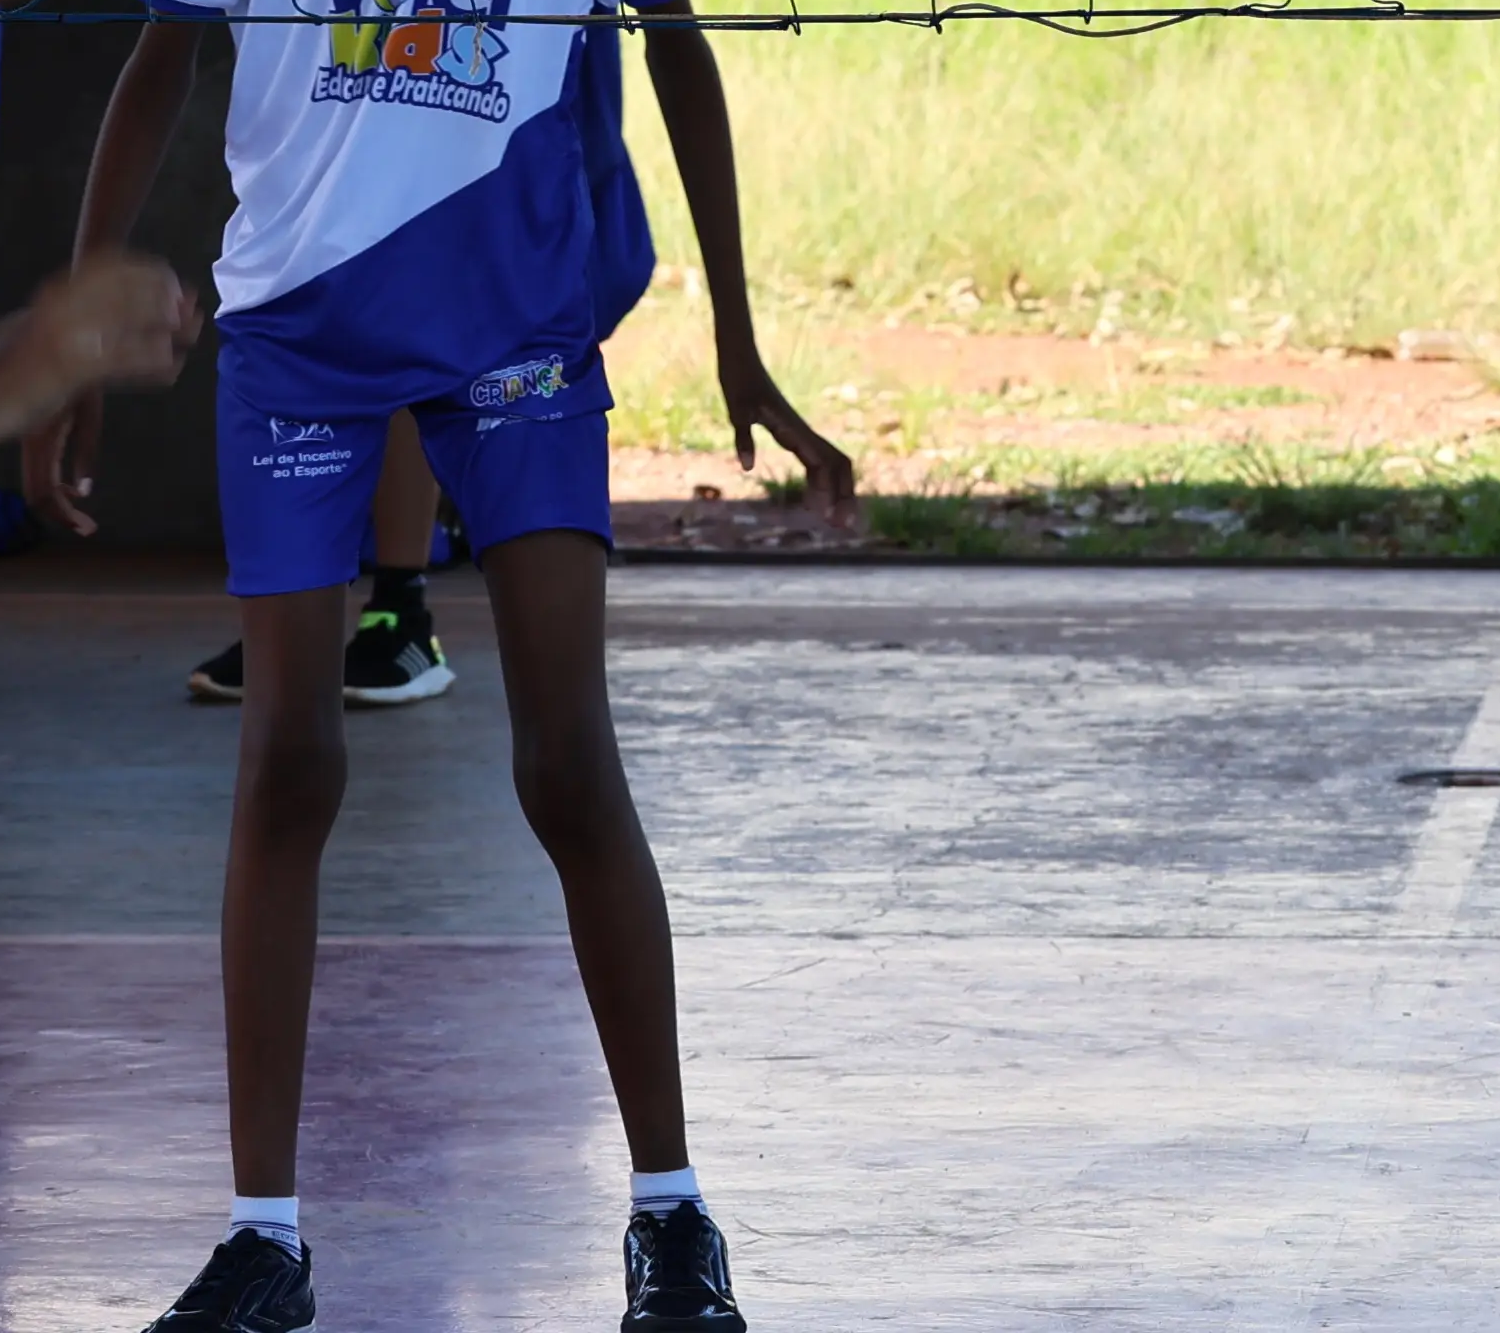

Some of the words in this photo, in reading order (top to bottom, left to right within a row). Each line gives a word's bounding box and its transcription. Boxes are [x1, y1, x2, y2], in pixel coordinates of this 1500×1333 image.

[388, 67, 510, 122] Praticando
[469, 364, 570, 407] CRIANÇA
[253, 454, 274, 466] Lei
[277, 453, 296, 465] de
[298, 449, 352, 462] Incentivo
[272, 468, 291, 478] ao
